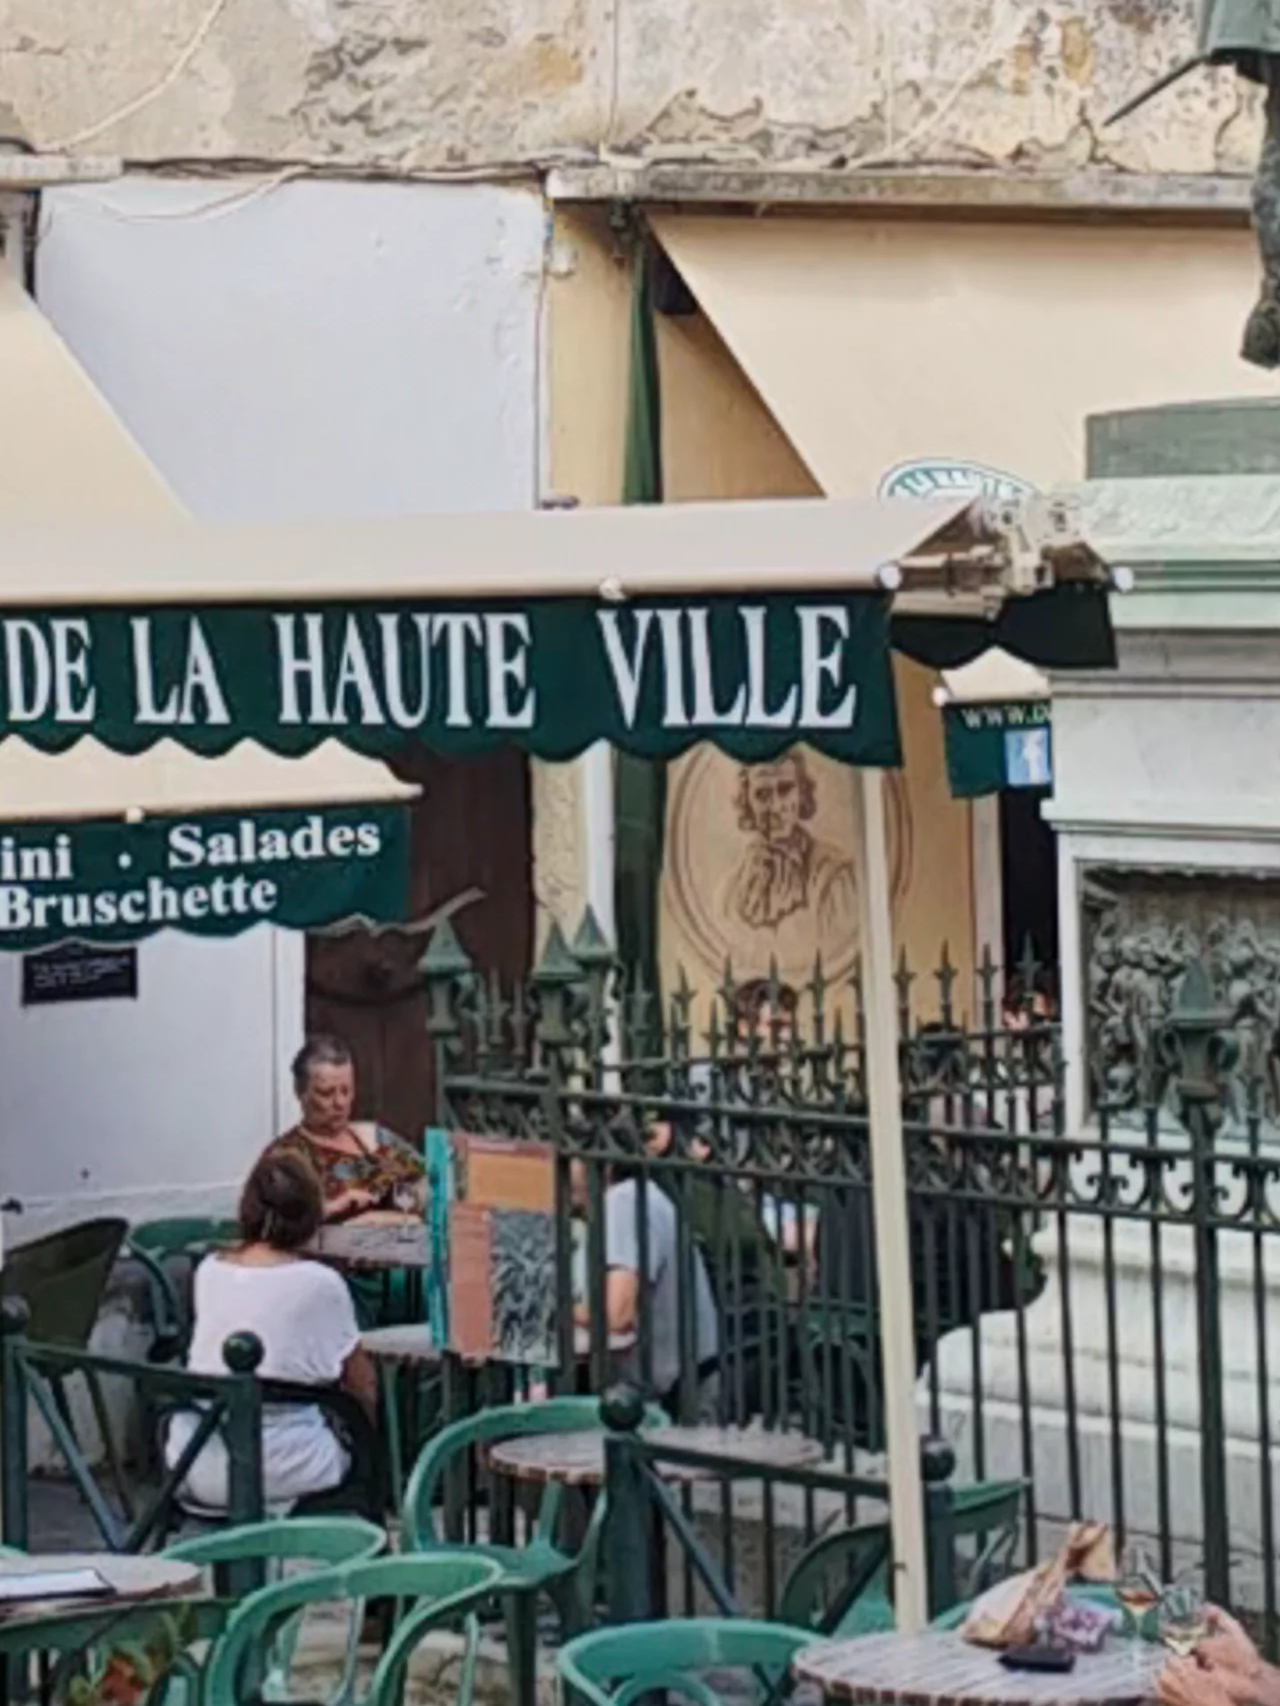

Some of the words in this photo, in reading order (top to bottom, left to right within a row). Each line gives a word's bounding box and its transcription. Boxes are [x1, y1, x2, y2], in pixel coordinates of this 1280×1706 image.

[4, 616, 96, 725] DE
[130, 614, 230, 726] LA
[277, 609, 536, 728] HAUTE
[597, 604, 858, 731] VILLE
[168, 819, 381, 870] Salades
